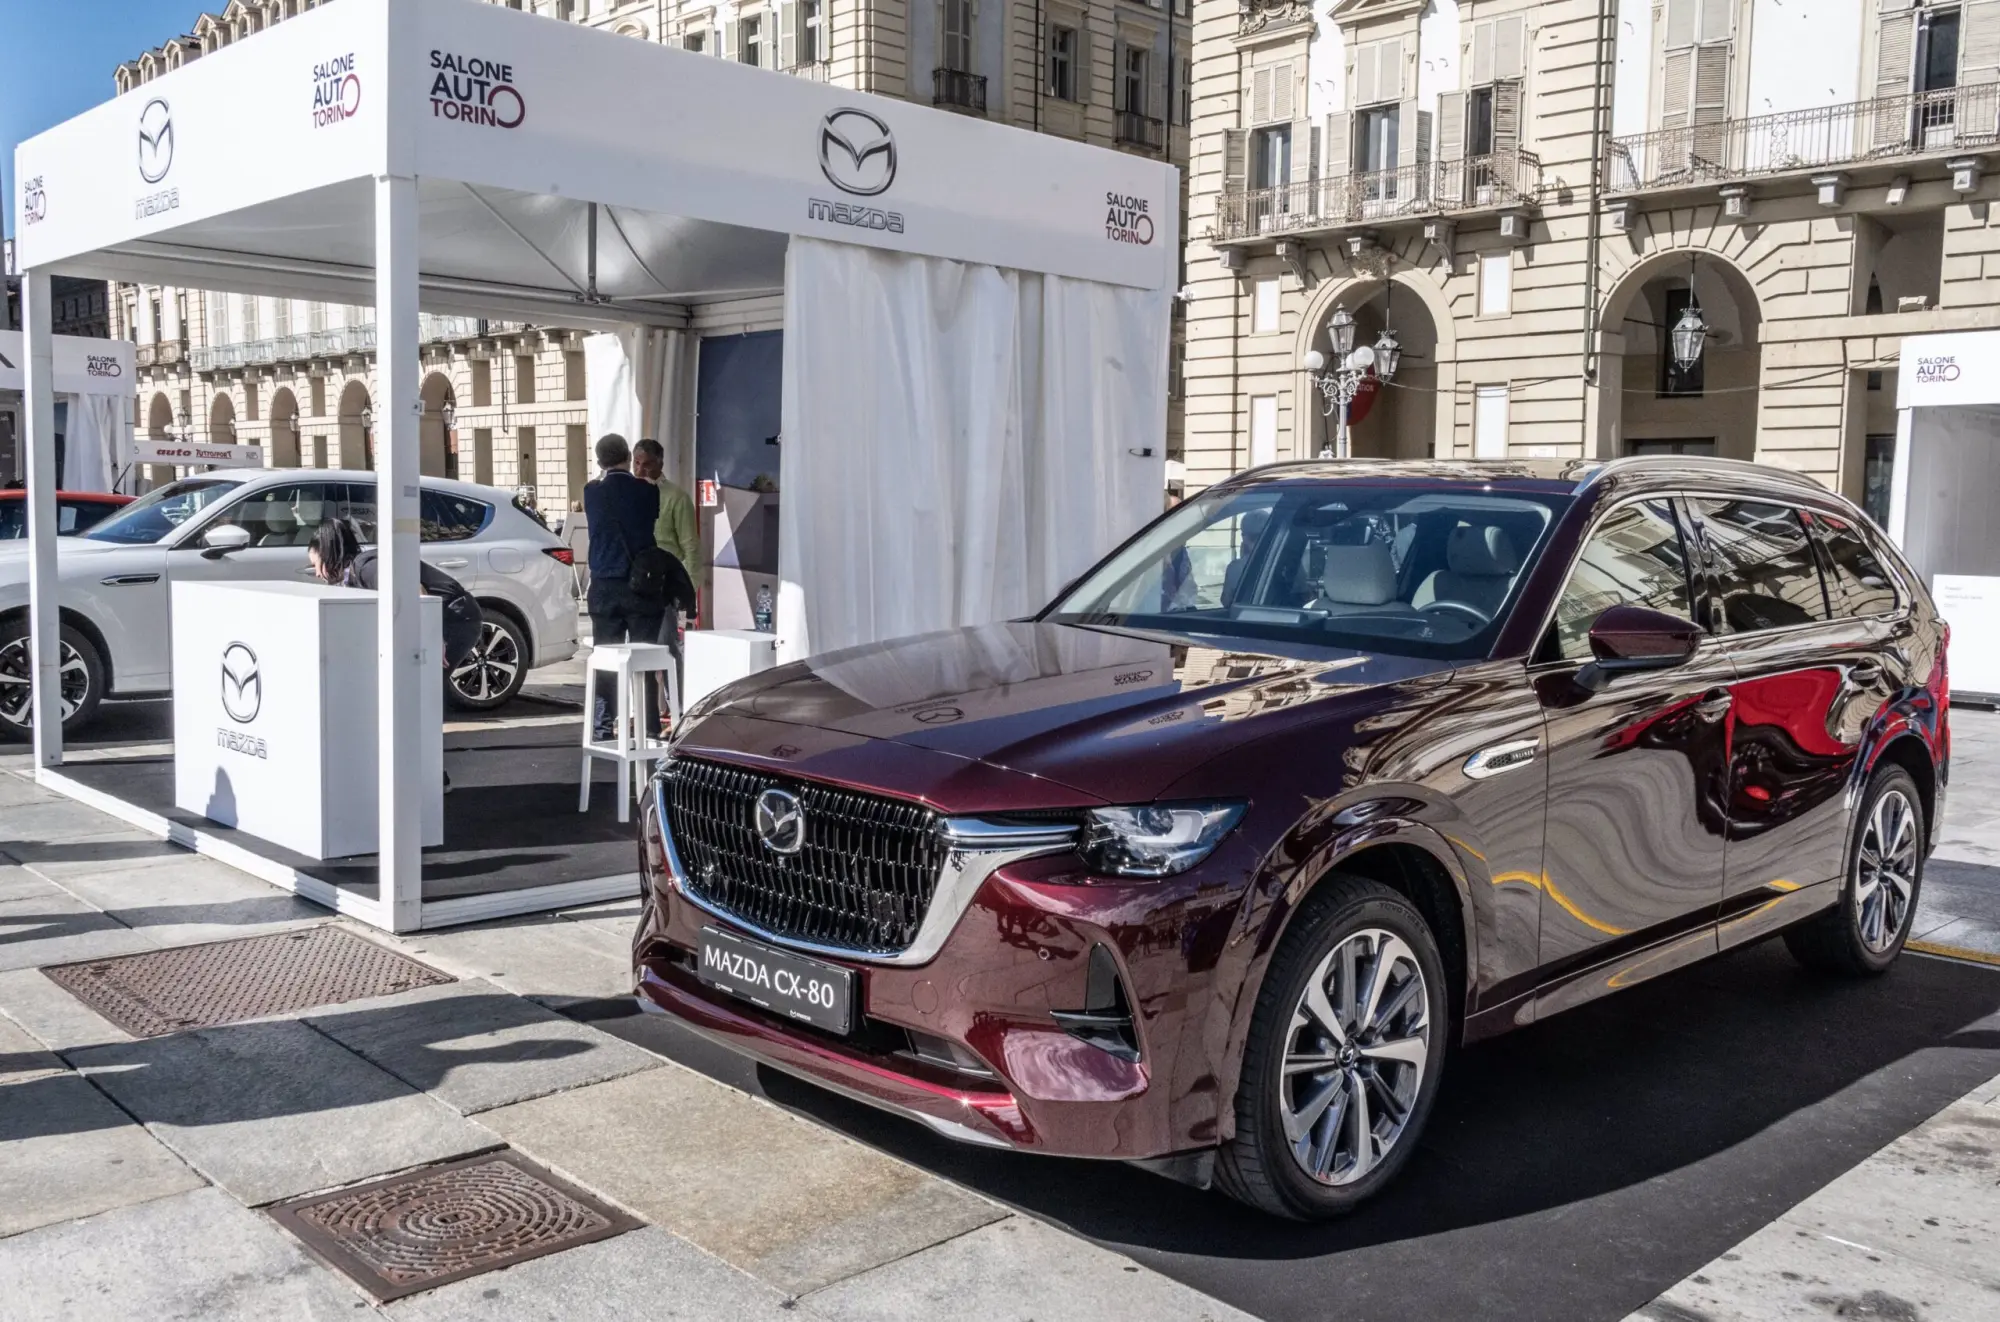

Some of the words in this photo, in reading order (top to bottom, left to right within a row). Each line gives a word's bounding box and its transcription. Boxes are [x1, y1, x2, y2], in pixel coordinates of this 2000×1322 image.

[313, 53, 355, 82] SALONE
[430, 50, 513, 83] SALONE
[313, 73, 361, 118] AUTO
[430, 72, 526, 128] AUTO
[25, 176, 43, 193] SALONE
[808, 198, 905, 234] mazda
[1106, 192, 1149, 212] SALONE
[1106, 208, 1154, 245] AUTO
[87, 355, 117, 363] SALONE
[87, 362, 122, 377] AUTO
[1917, 356, 1956, 365] SALONE
[1917, 364, 1960, 381] AUTO
[156, 448, 192, 457] auto
[216, 727, 267, 760] mazda
[704, 944, 770, 988] MAZDA
[774, 969, 835, 1009] CX-80
